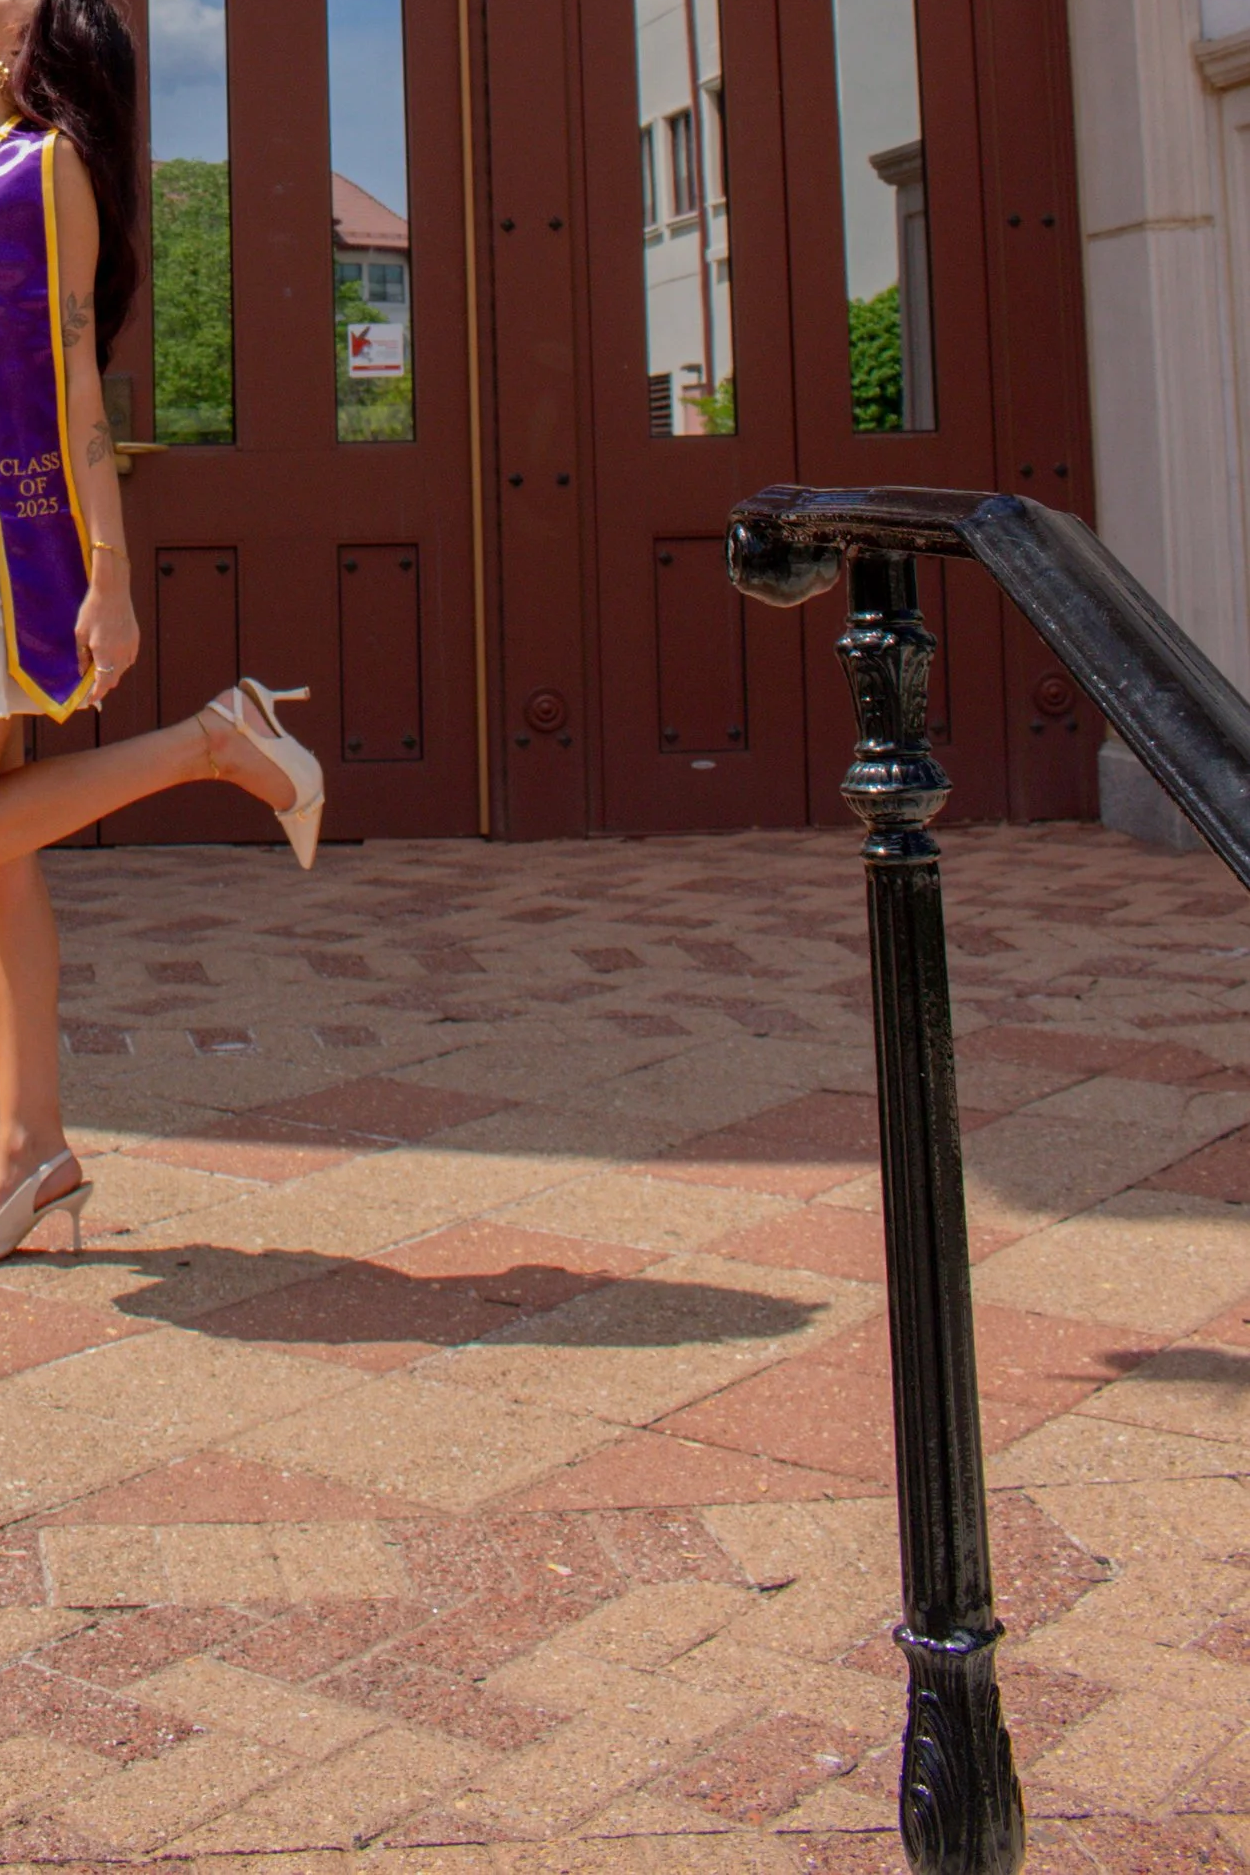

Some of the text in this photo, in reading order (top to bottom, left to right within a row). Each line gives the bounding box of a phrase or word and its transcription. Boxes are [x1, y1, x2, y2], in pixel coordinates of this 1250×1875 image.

[0, 452, 60, 476] CLASS
[20, 477, 47, 496] OF
[15, 497, 58, 518] 2025
